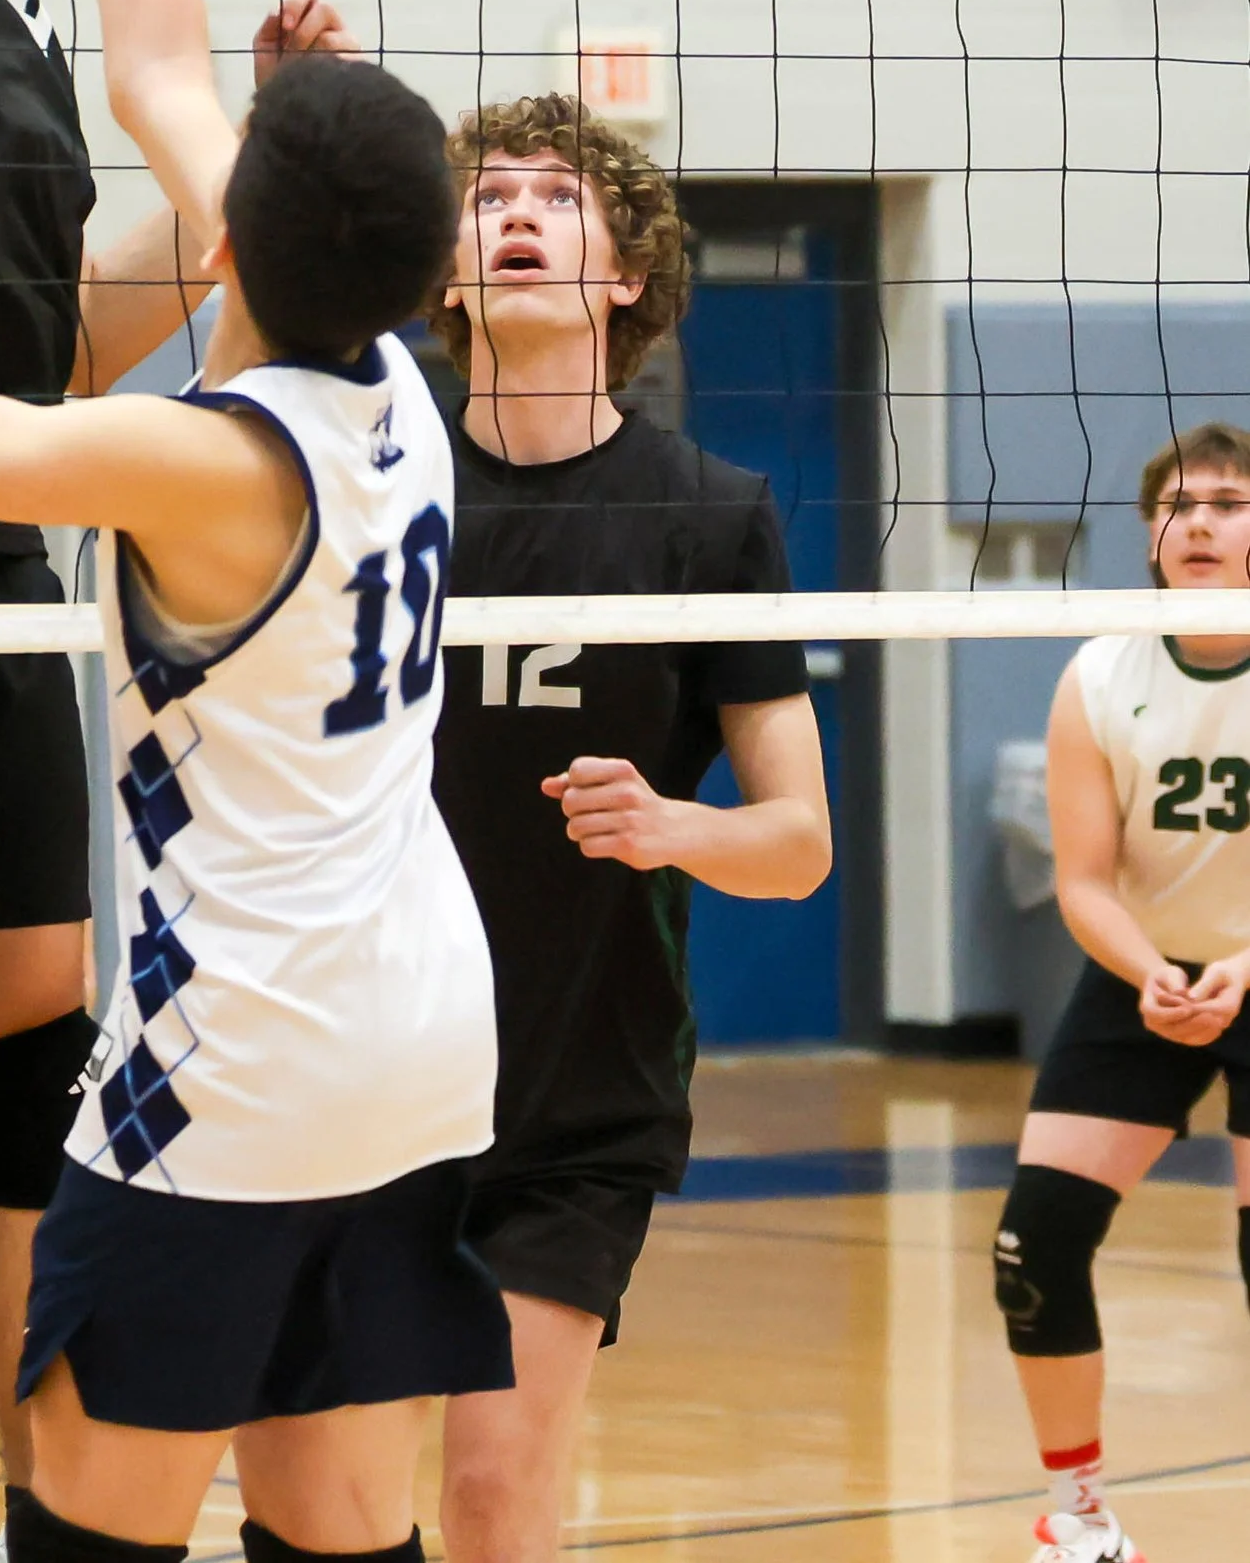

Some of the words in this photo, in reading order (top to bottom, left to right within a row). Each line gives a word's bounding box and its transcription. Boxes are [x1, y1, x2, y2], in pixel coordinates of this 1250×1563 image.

[323, 500, 450, 738] 10
[482, 644, 582, 709] 12
[1153, 756, 1250, 833] 23
